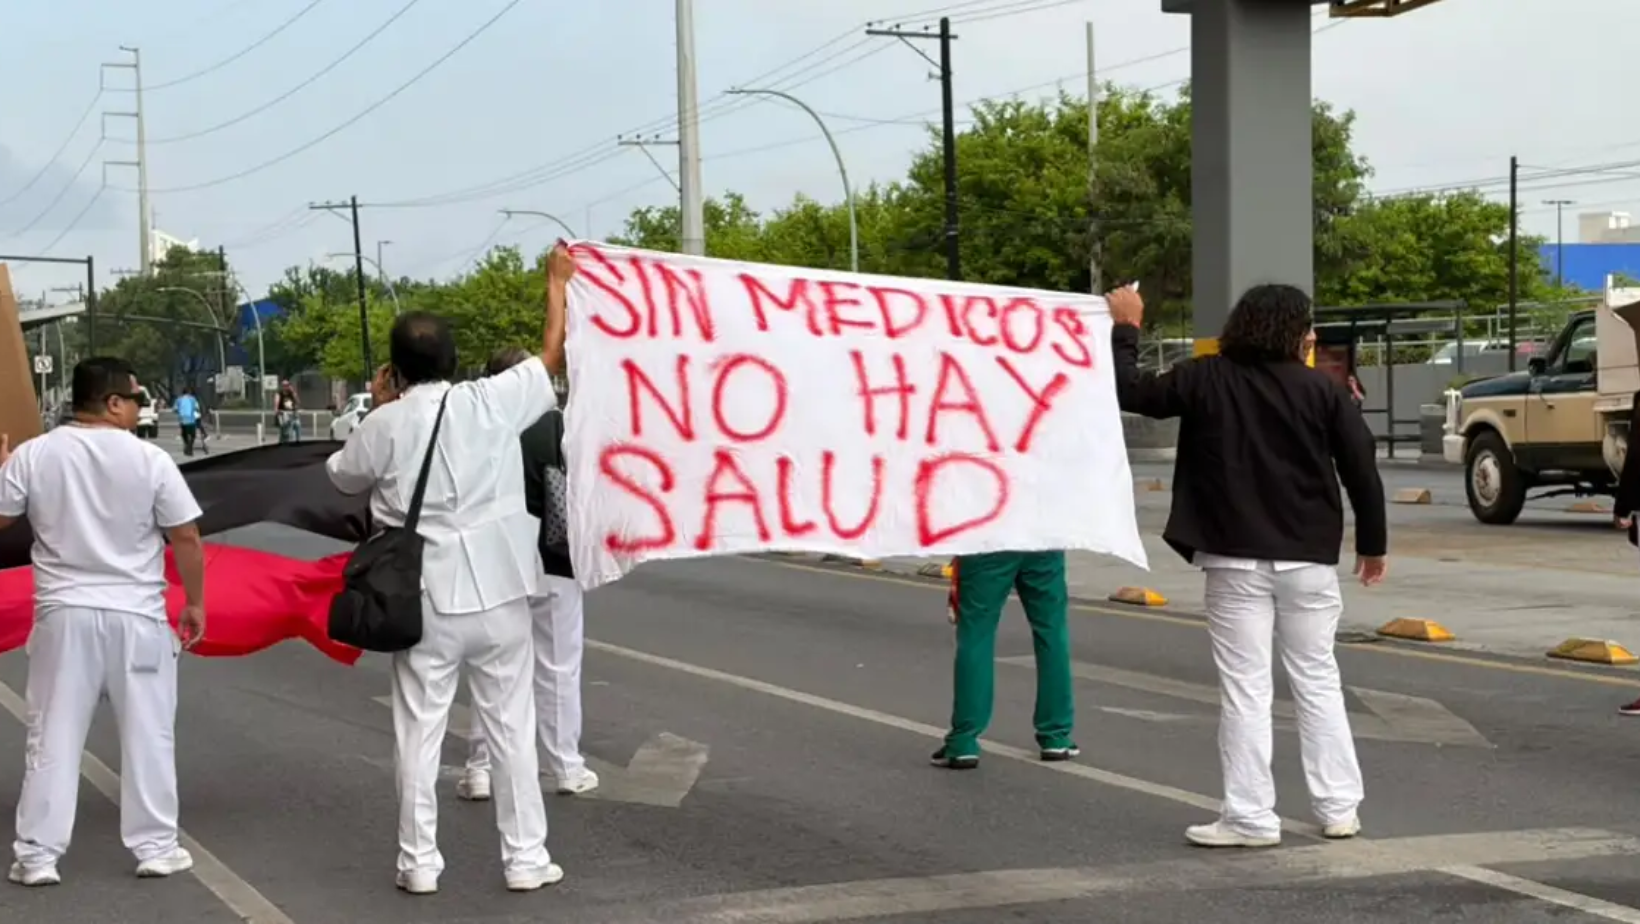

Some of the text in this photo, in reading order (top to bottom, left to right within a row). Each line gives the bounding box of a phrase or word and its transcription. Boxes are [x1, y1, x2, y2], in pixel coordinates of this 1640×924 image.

[568, 243, 1094, 369] SIN MEDICOS
[621, 349, 1069, 454] NO HAY
[600, 445, 1009, 553] SALUD
